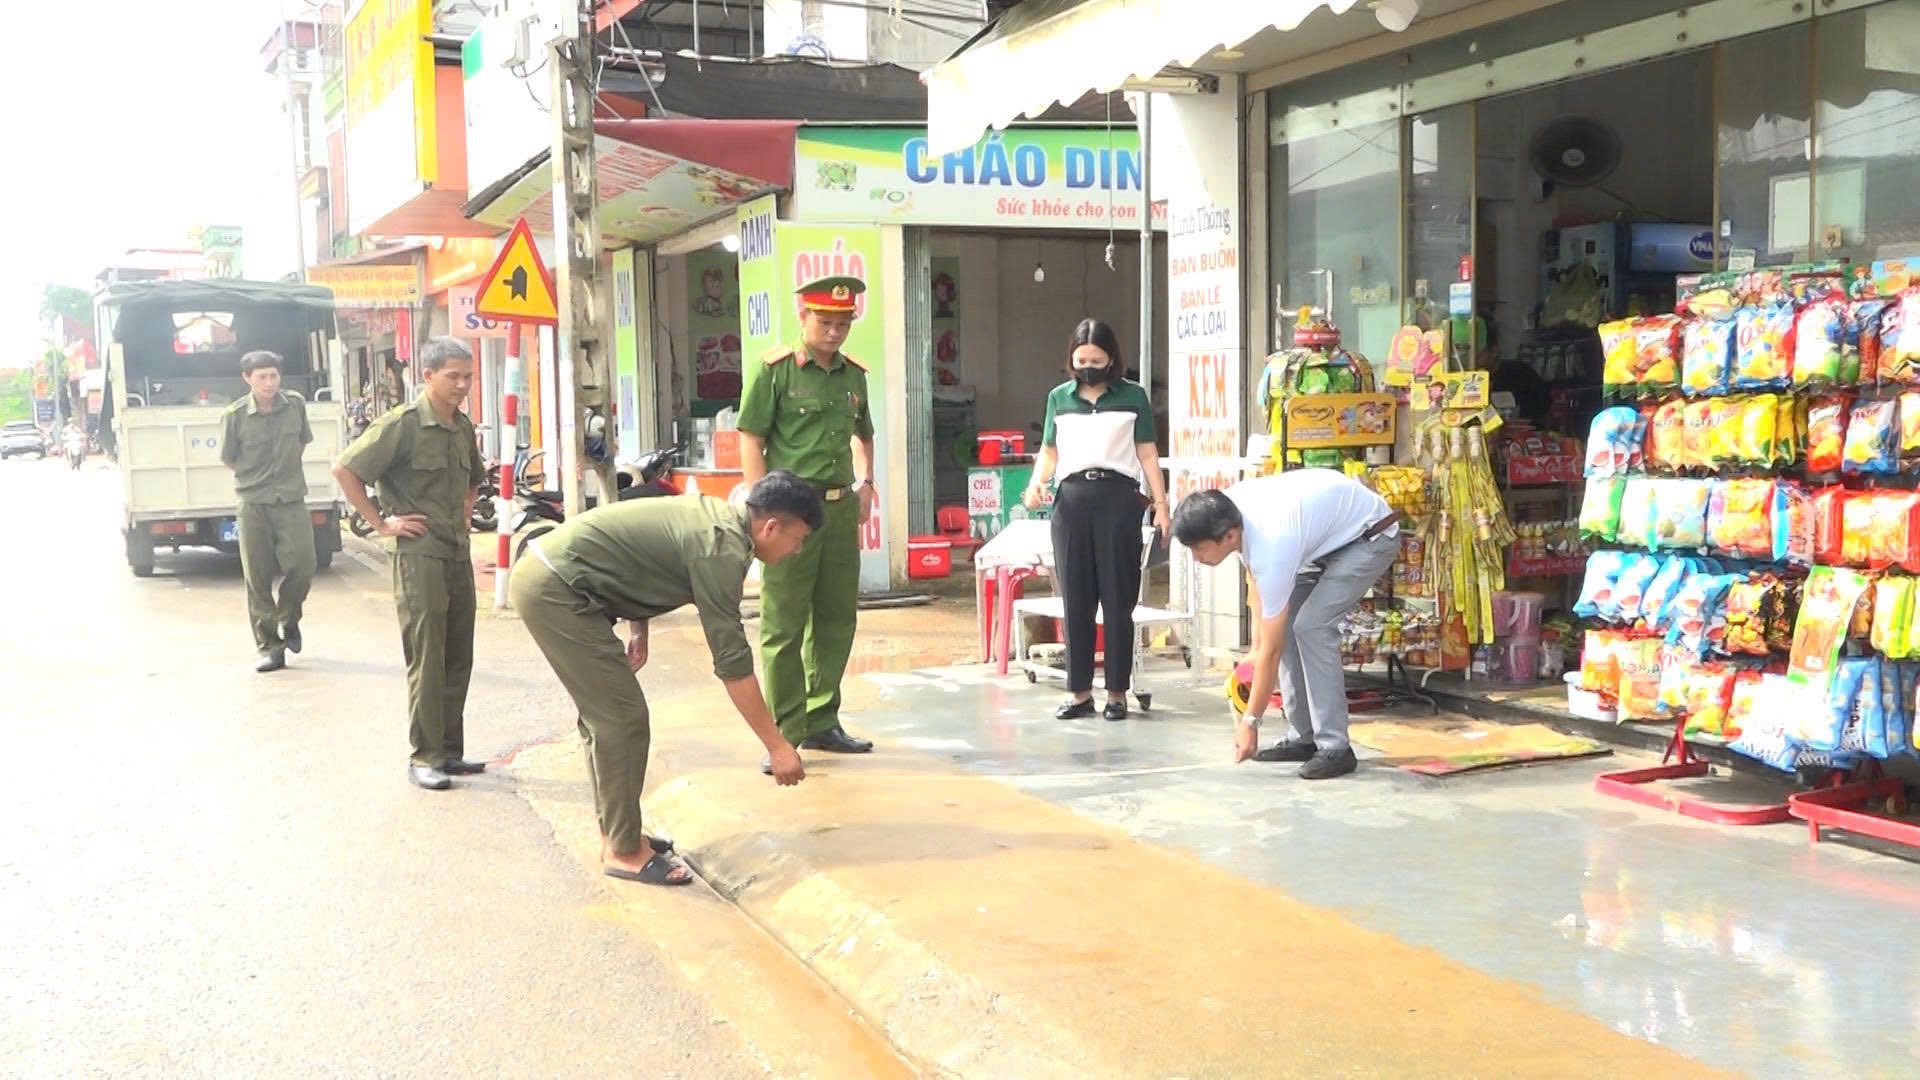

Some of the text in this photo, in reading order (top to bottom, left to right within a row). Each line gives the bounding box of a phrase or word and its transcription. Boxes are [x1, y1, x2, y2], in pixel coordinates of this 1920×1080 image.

[905, 131, 1047, 188] CHÁO
[996, 197, 1027, 216] Sức
[1031, 197, 1070, 216] khỏe
[1076, 199, 1104, 218] cho
[1109, 204, 1136, 218] con
[740, 208, 773, 262] DÀNH
[747, 291, 770, 336] CHO
[1188, 352, 1228, 418] KEM
